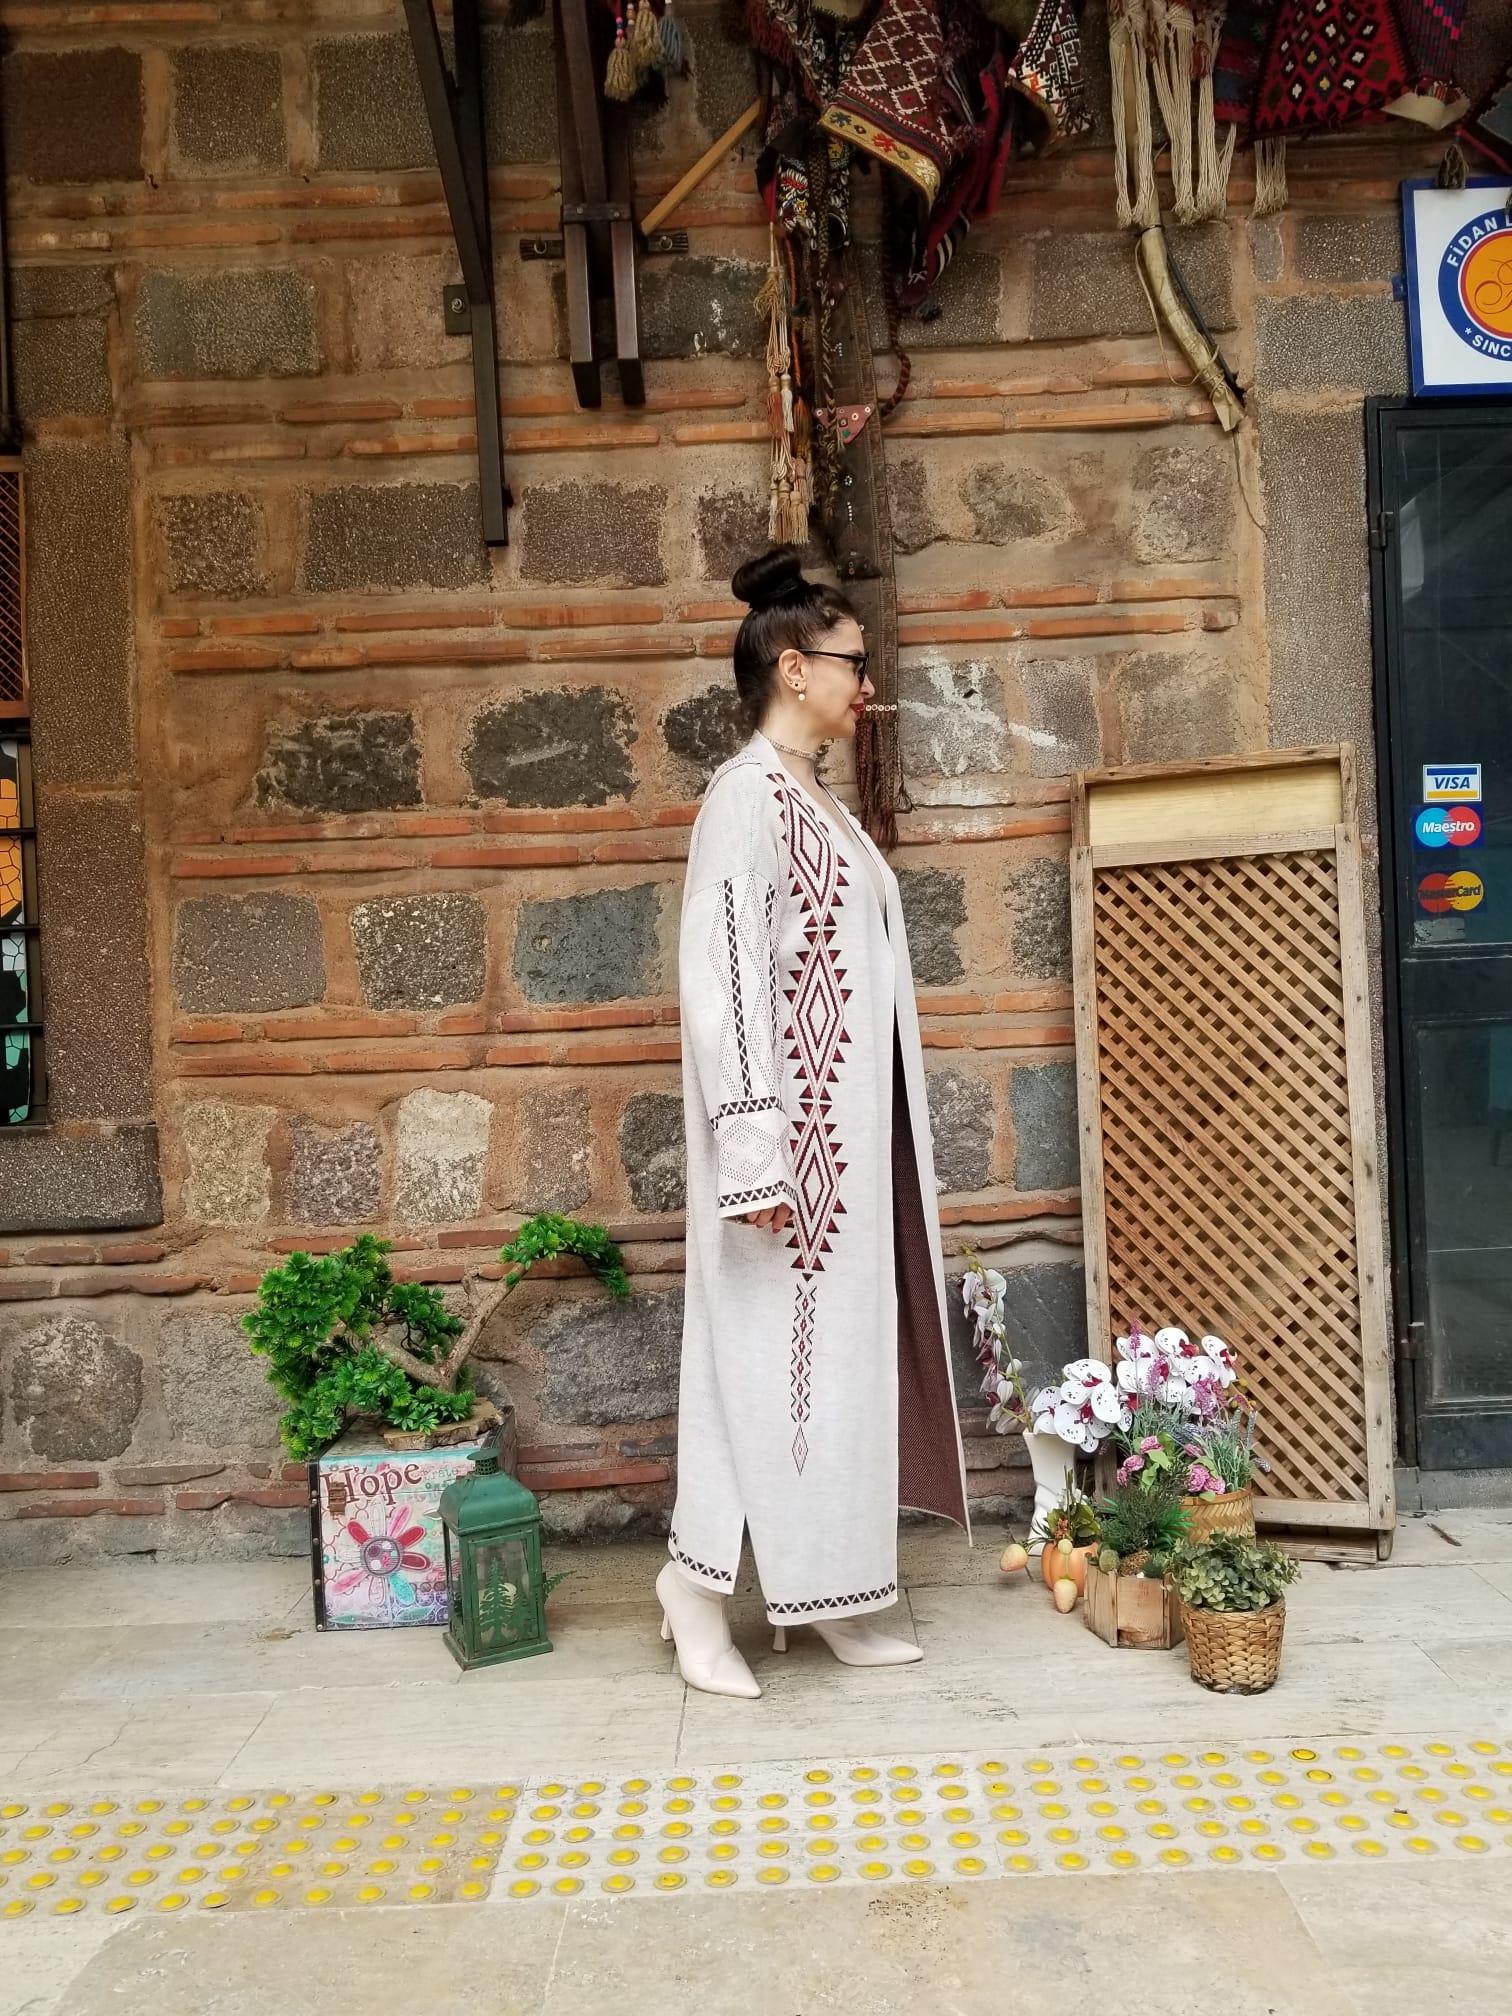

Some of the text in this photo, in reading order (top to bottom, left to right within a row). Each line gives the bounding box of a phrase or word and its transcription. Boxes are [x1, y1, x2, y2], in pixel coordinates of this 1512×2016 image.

[1447, 216, 1498, 268] FİDAN
[1434, 776, 1470, 789] VISA
[1422, 820, 1475, 833] Maestro
[319, 1463, 422, 1508] Hope
